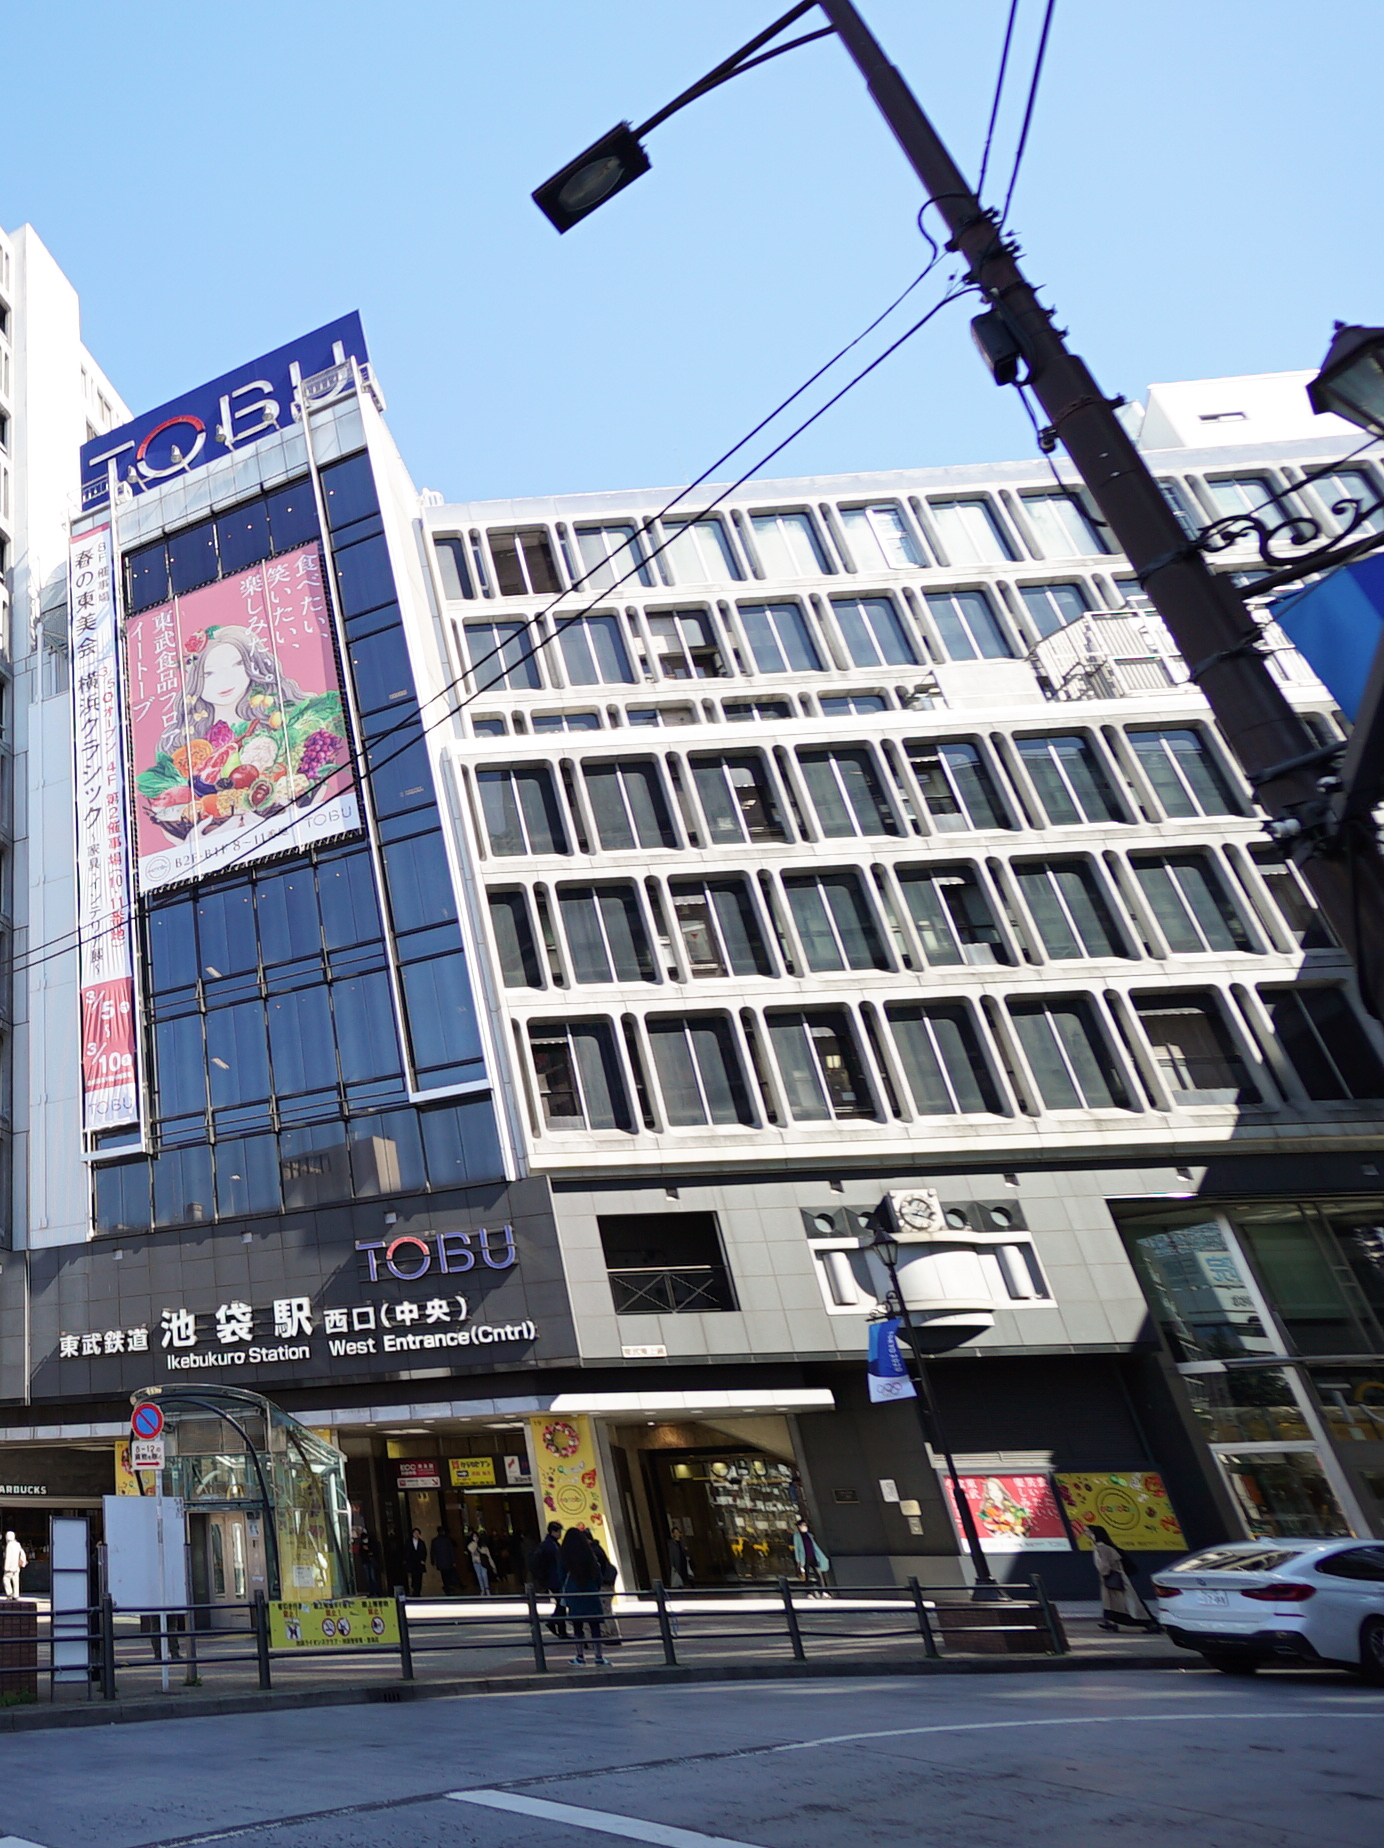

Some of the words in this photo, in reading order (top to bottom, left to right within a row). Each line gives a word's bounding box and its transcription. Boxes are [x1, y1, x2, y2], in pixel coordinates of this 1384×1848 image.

[89, 340, 347, 500] TOBU
[267, 563, 300, 649] 笑いたい、
[294, 553, 329, 638] 食べたい、
[130, 621, 155, 723] イートーブ
[152, 609, 180, 750] 東武食品フロア
[305, 806, 352, 829] TOBU
[88, 1097, 133, 1115] TOBU
[355, 1224, 517, 1282] TOBU
[58, 1328, 149, 1359] 東武鉄道
[160, 1295, 314, 1349] 池袋駅
[167, 1352, 246, 1371] Ikebukuro
[248, 1345, 311, 1364] Station
[328, 1337, 377, 1357] West
[383, 1320, 537, 1352] Entrance(Cntrl)
